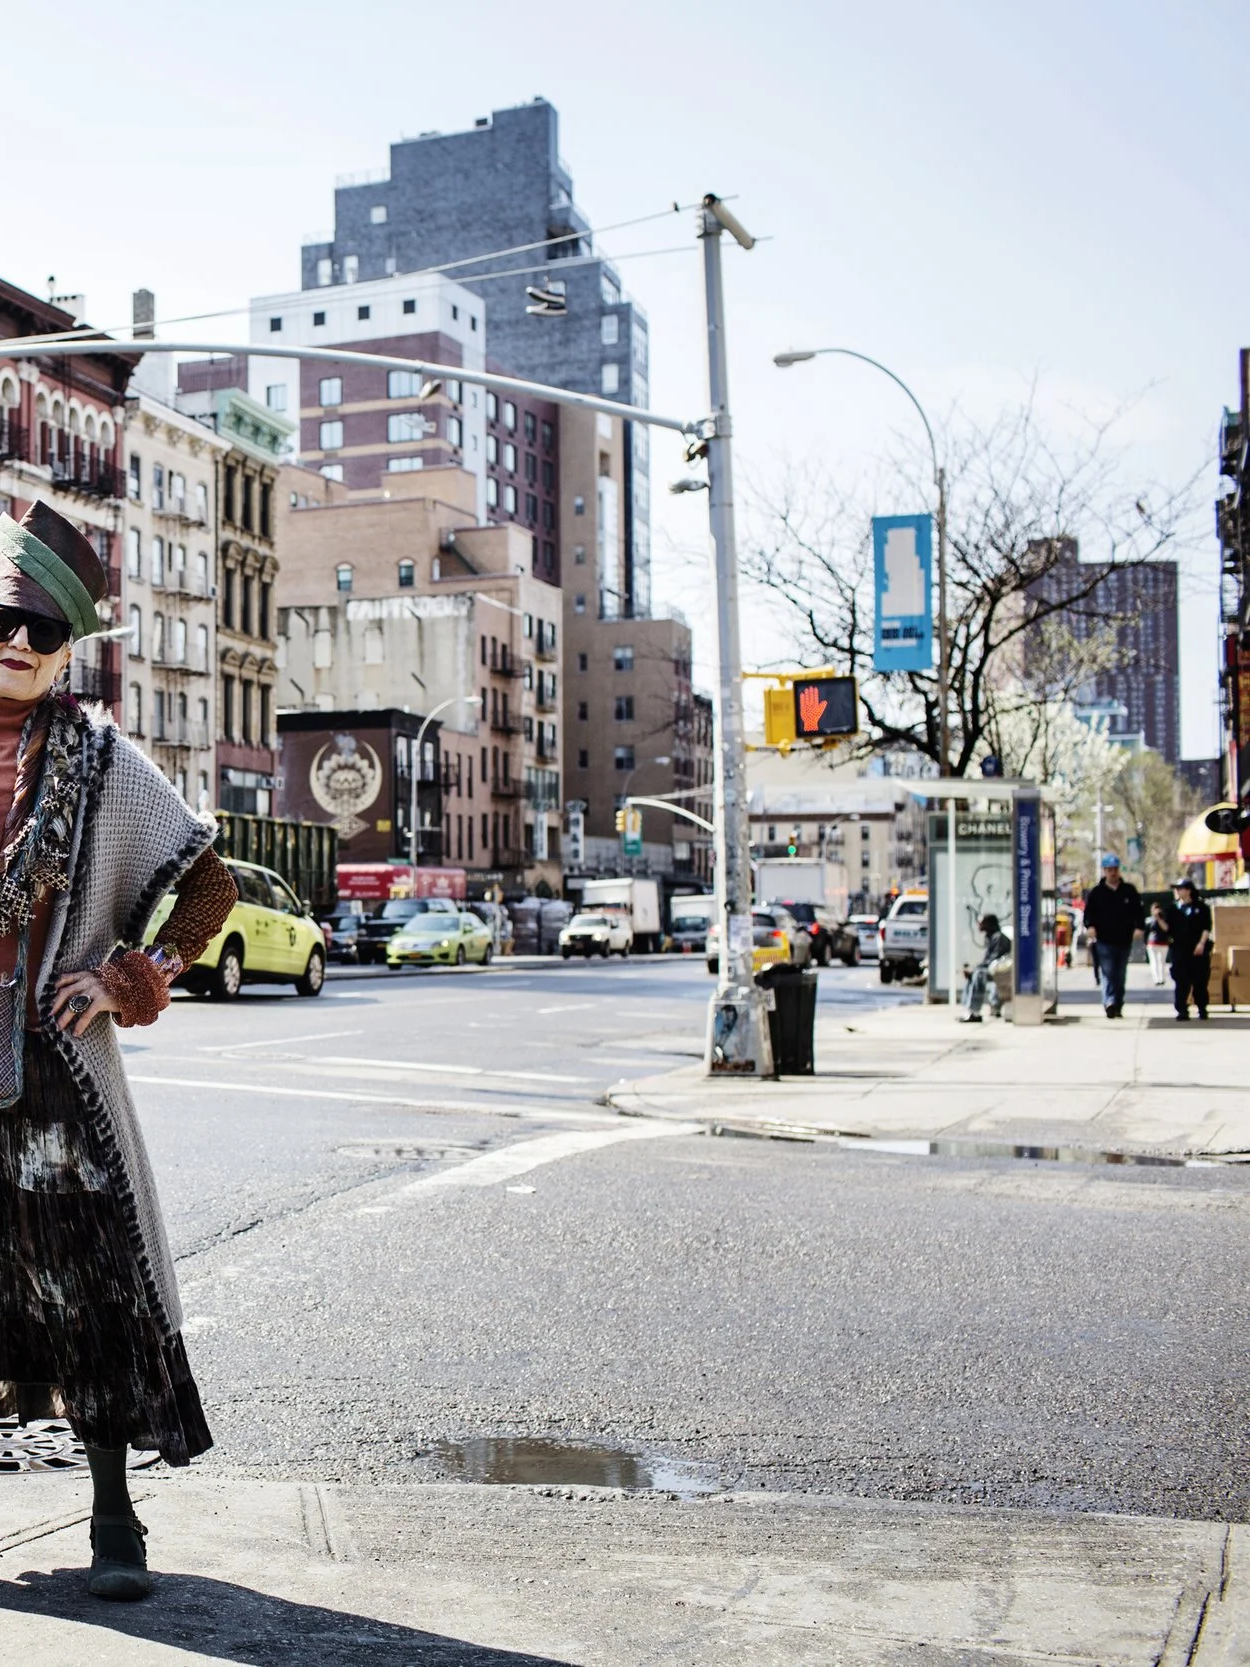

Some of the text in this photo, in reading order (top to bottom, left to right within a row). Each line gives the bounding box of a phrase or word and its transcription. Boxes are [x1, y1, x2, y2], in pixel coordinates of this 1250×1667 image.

[958, 822, 1012, 835] CHANEL
[1018, 816, 1031, 857] Bowery
[1020, 868, 1031, 904] Prince
[1020, 905, 1031, 936] Street
